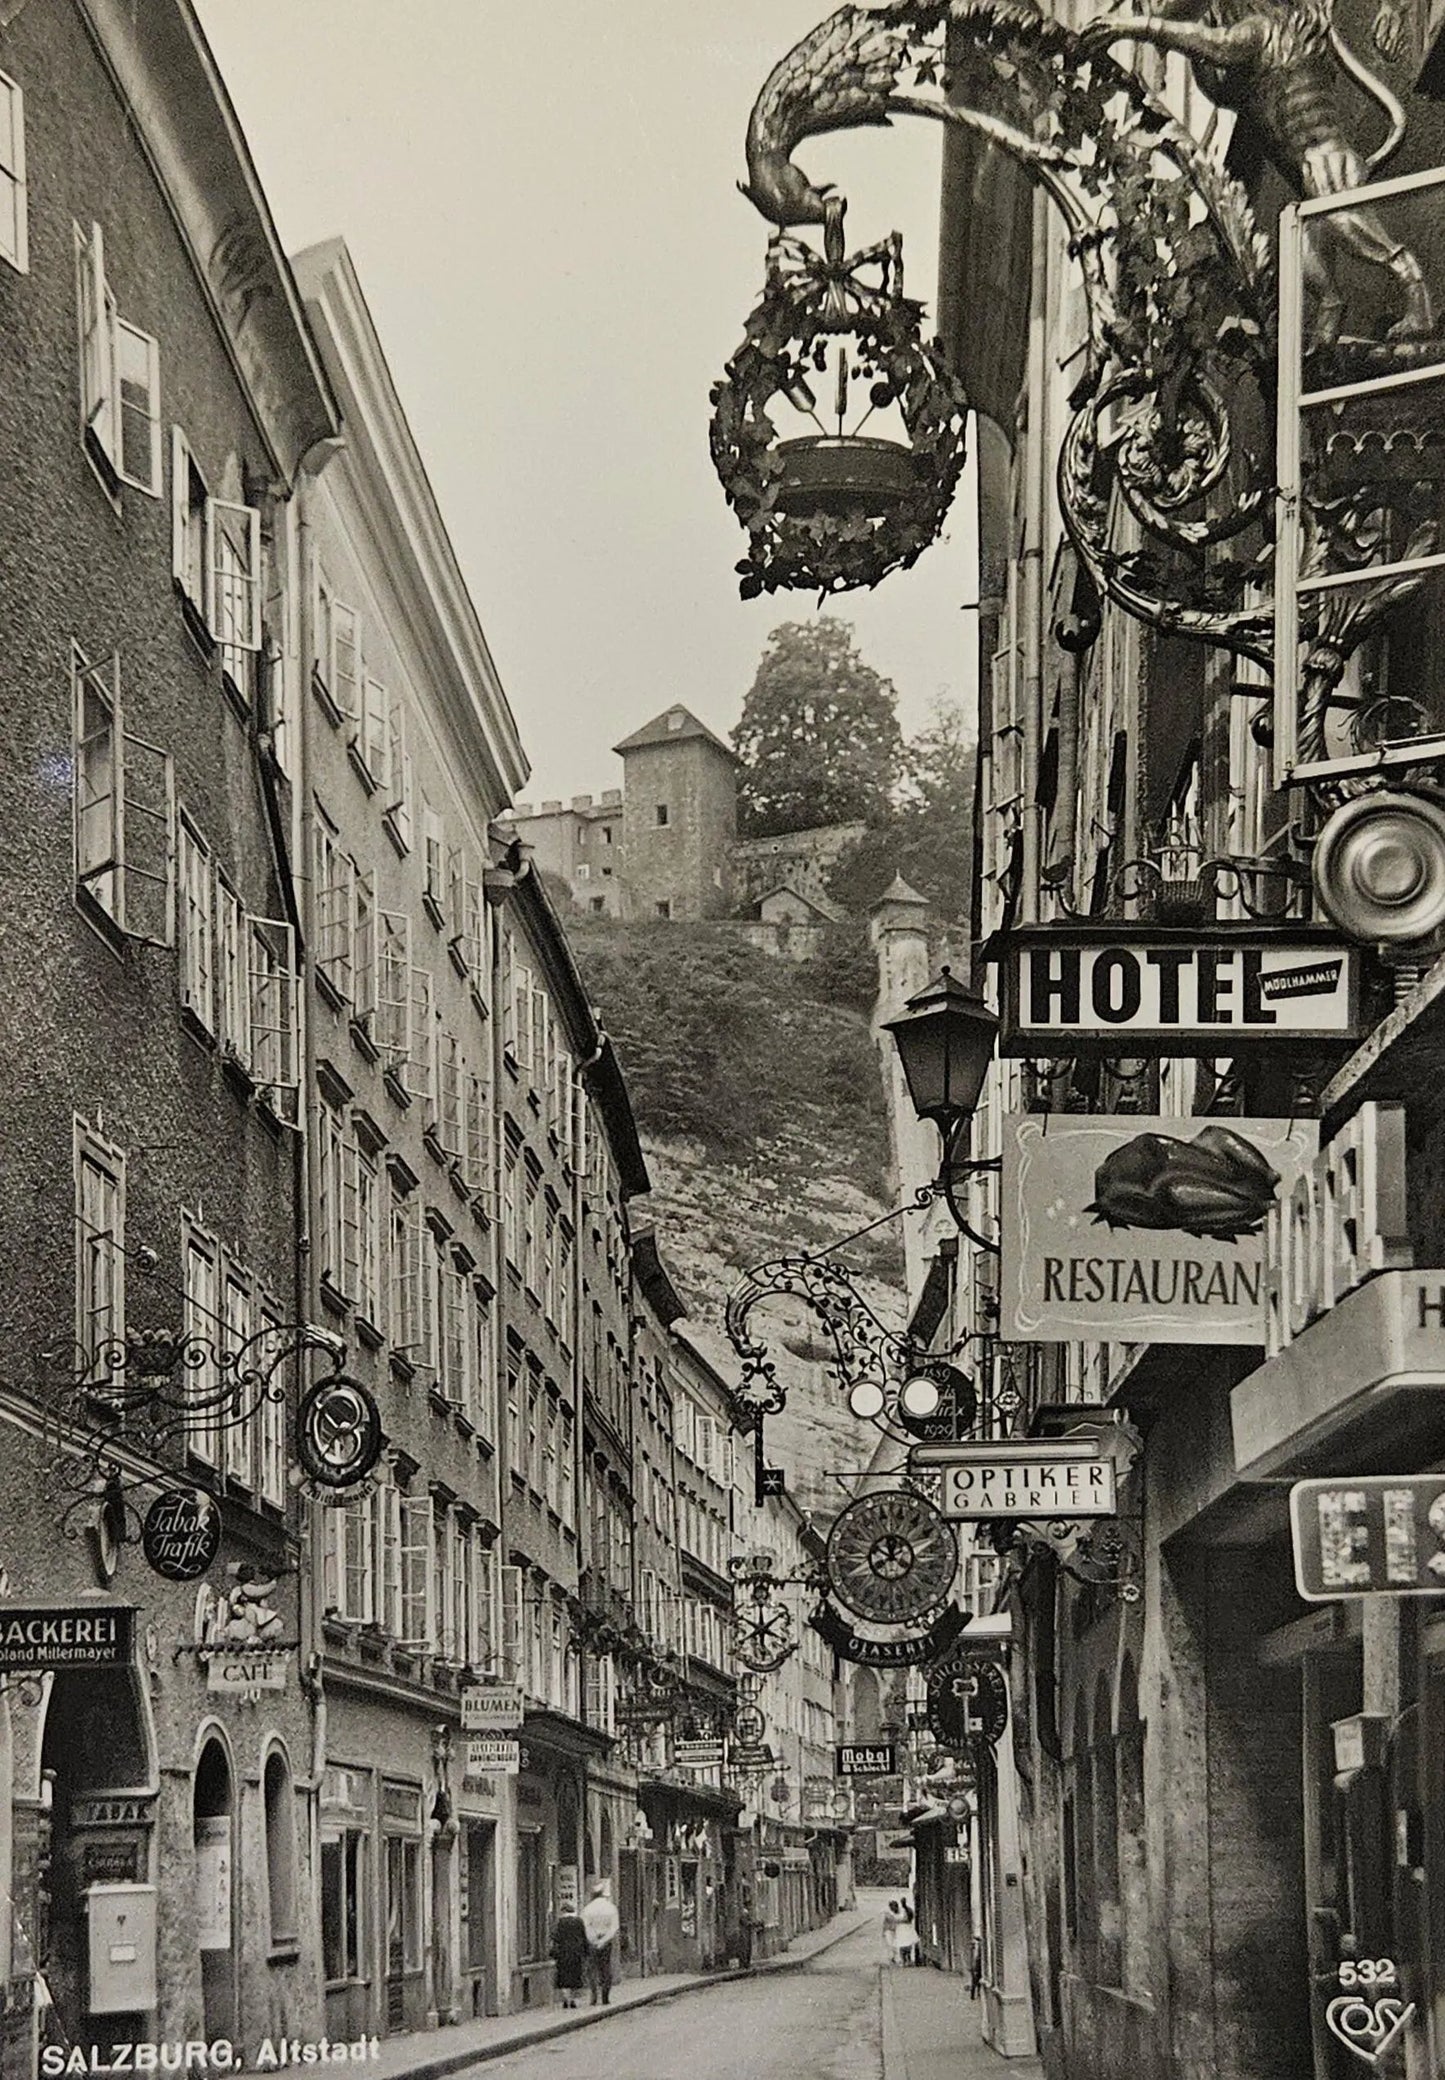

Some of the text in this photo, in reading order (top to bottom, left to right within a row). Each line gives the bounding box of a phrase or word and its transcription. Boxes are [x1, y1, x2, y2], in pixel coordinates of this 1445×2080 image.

[1030, 948, 1277, 1024] HOTEL
[1264, 1100, 1386, 1358] HOTEL
[1043, 1257, 1261, 1306] RESTAURAN
[953, 1466, 1103, 1490] OPTIKER
[954, 1490, 1102, 1509] GABRIEL
[151, 1498, 213, 1533] Tabak
[153, 1533, 213, 1566] Trafik
[0, 1617, 116, 1645] ÄCKEREI
[464, 1699, 520, 1713] BLUMEN
[947, 1848, 969, 1862] EIS
